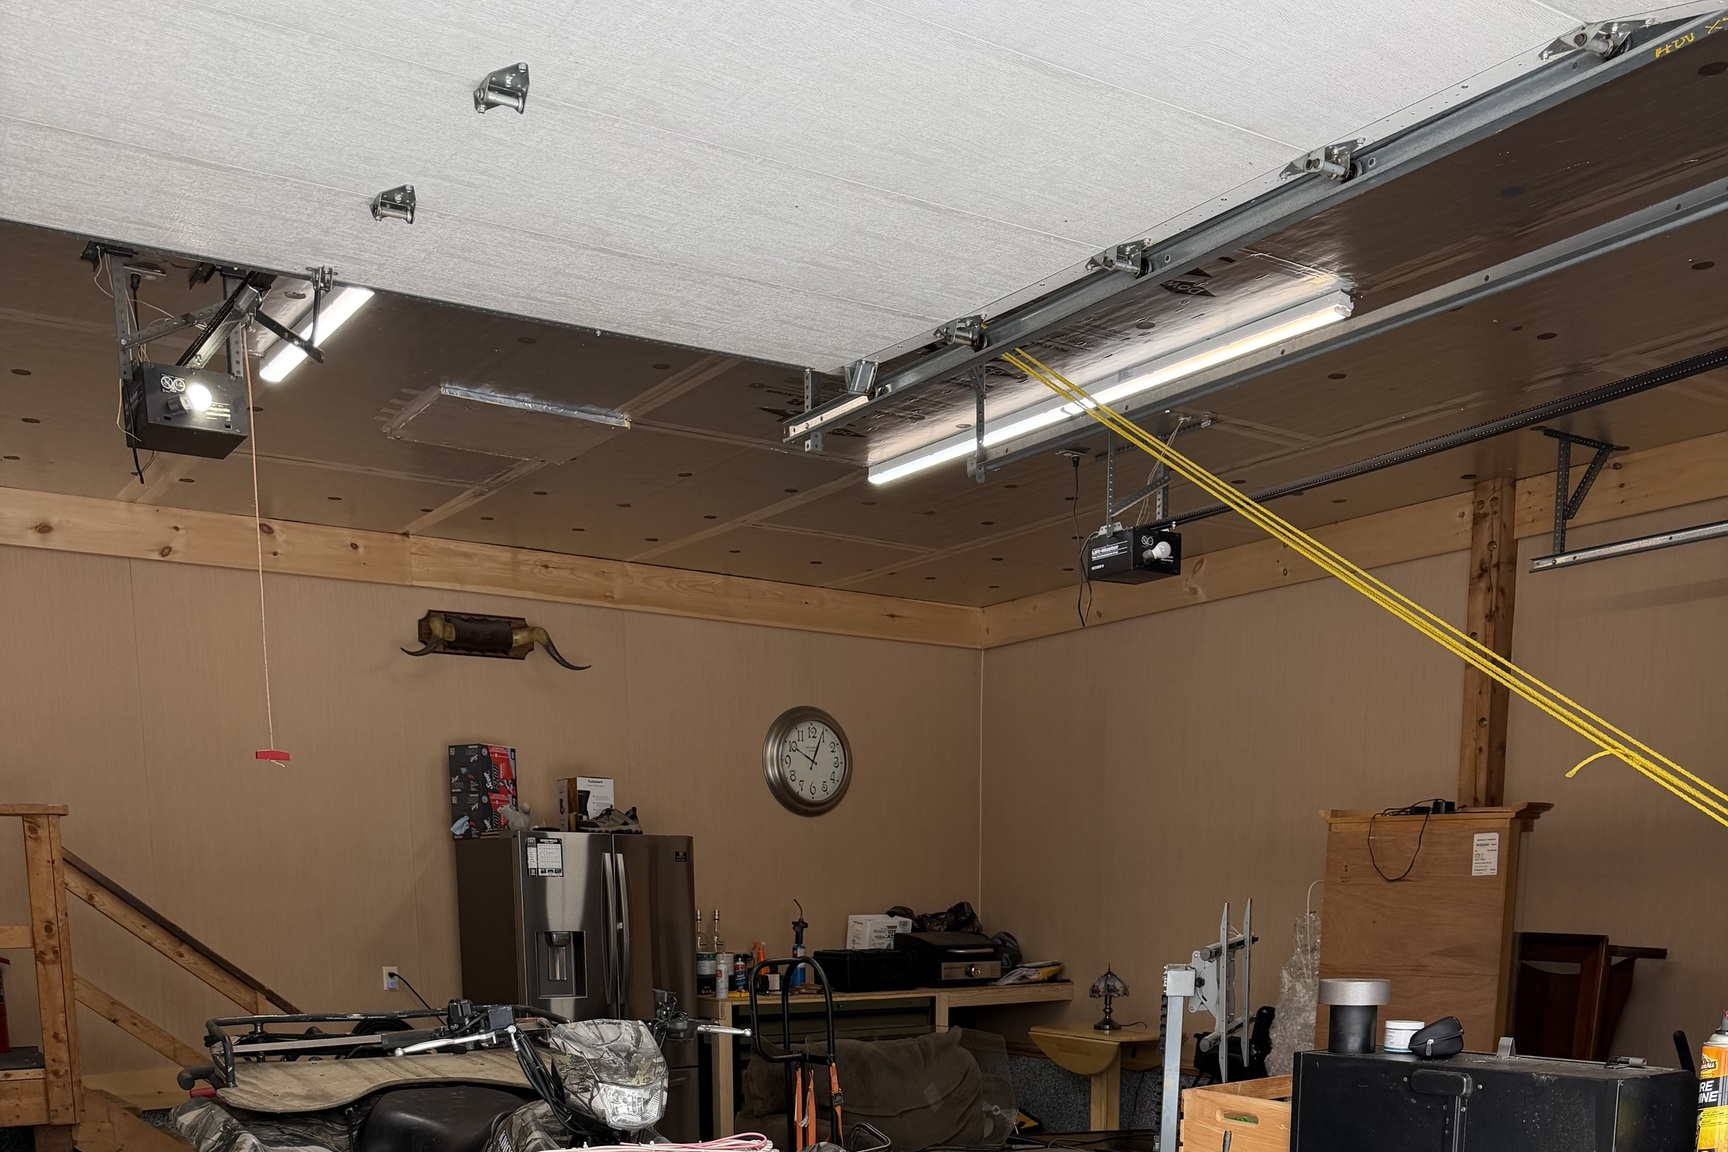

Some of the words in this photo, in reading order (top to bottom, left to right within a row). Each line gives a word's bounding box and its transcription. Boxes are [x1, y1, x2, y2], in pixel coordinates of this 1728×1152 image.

[797, 730, 804, 742] 11
[808, 726, 817, 739] 12
[788, 740, 798, 752] 10
[829, 741, 836, 753] 2
[784, 754, 792, 768] 9
[832, 756, 840, 768] 3
[789, 769, 797, 782] 8
[830, 771, 836, 783] 4
[799, 779, 805, 791] 7
[809, 781, 817, 795] 6
[821, 780, 828, 792] 5
[1700, 1080, 1715, 1092] RE
